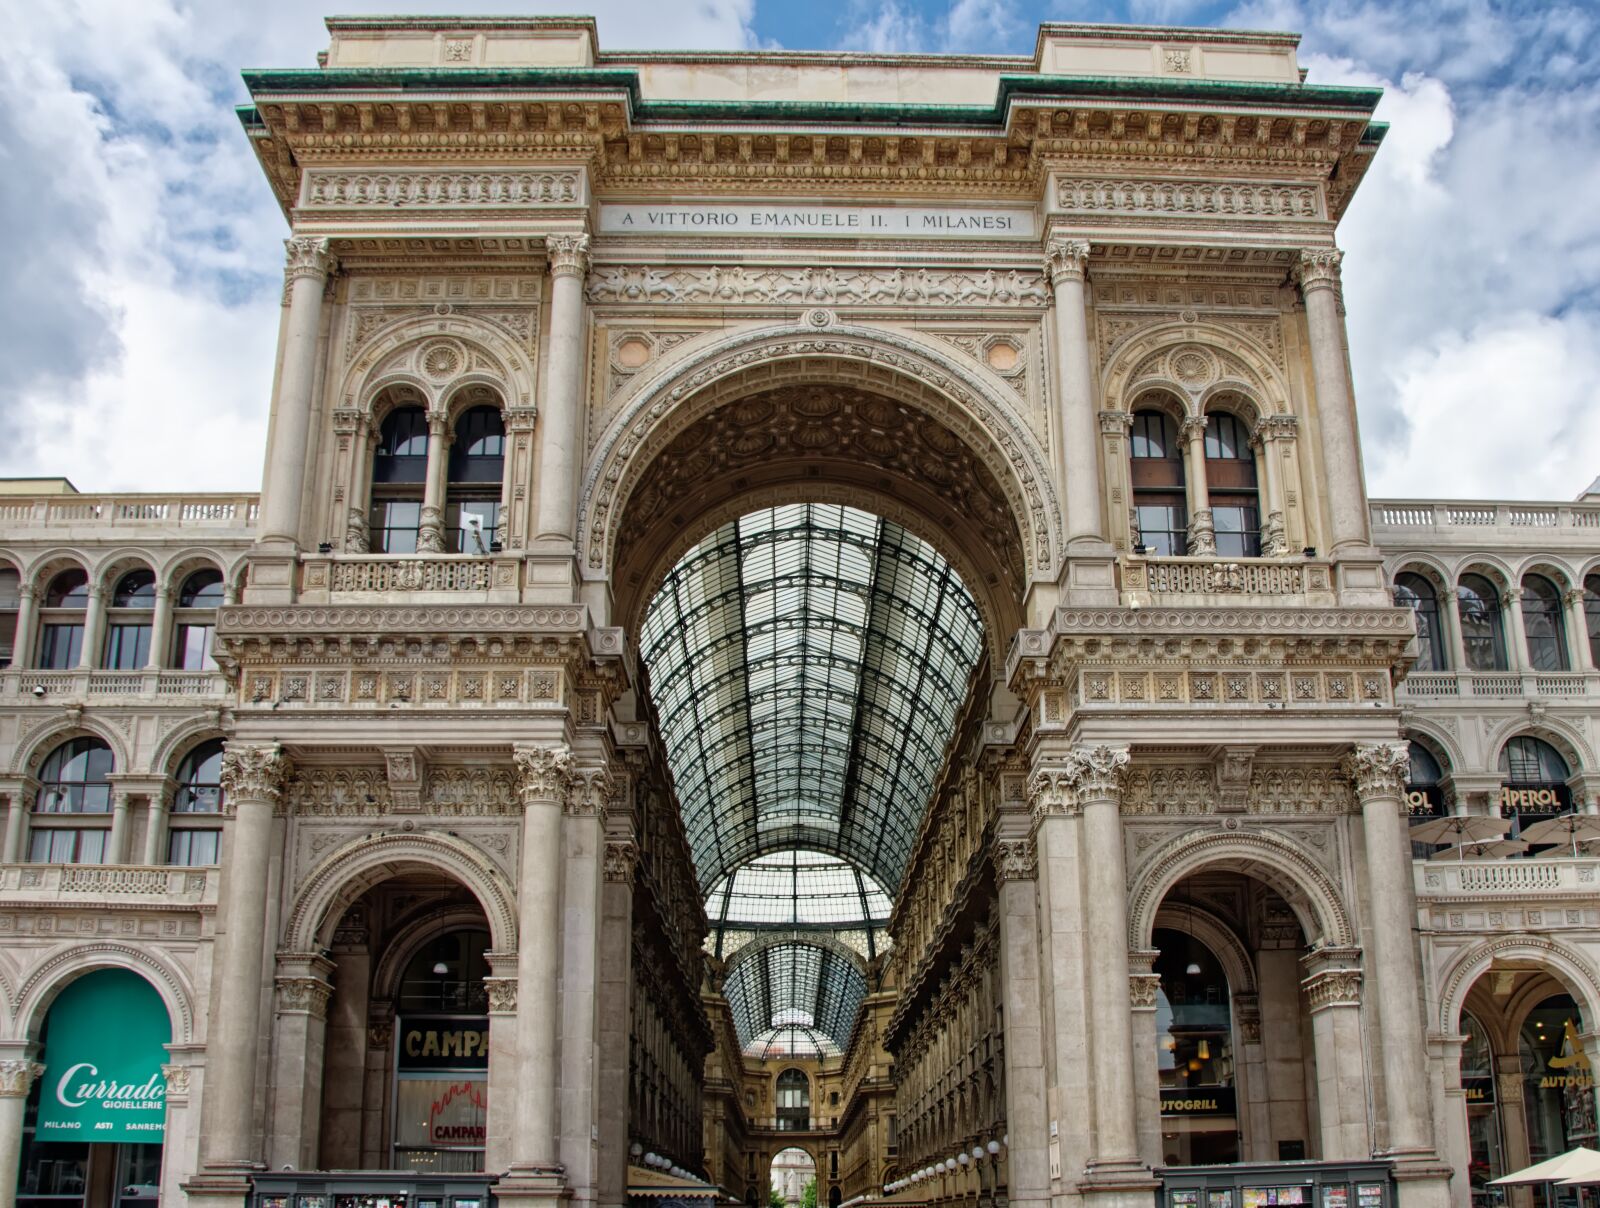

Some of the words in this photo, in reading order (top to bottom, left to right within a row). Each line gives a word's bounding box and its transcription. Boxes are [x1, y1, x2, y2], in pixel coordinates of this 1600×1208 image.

[622, 212, 634, 225] A
[648, 212, 739, 226] VITTORIO
[750, 213, 859, 227] EMANUELE
[871, 214, 888, 228] II.
[922, 215, 1012, 230] MILANESI
[1500, 786, 1562, 807] APEROL
[405, 1030, 489, 1057] CAMPA
[102, 1100, 163, 1110] GIOIELLERIE
[1160, 1099, 1218, 1111] UTOGRILL
[44, 1121, 81, 1129] MILANO
[94, 1122, 113, 1130] ASTI
